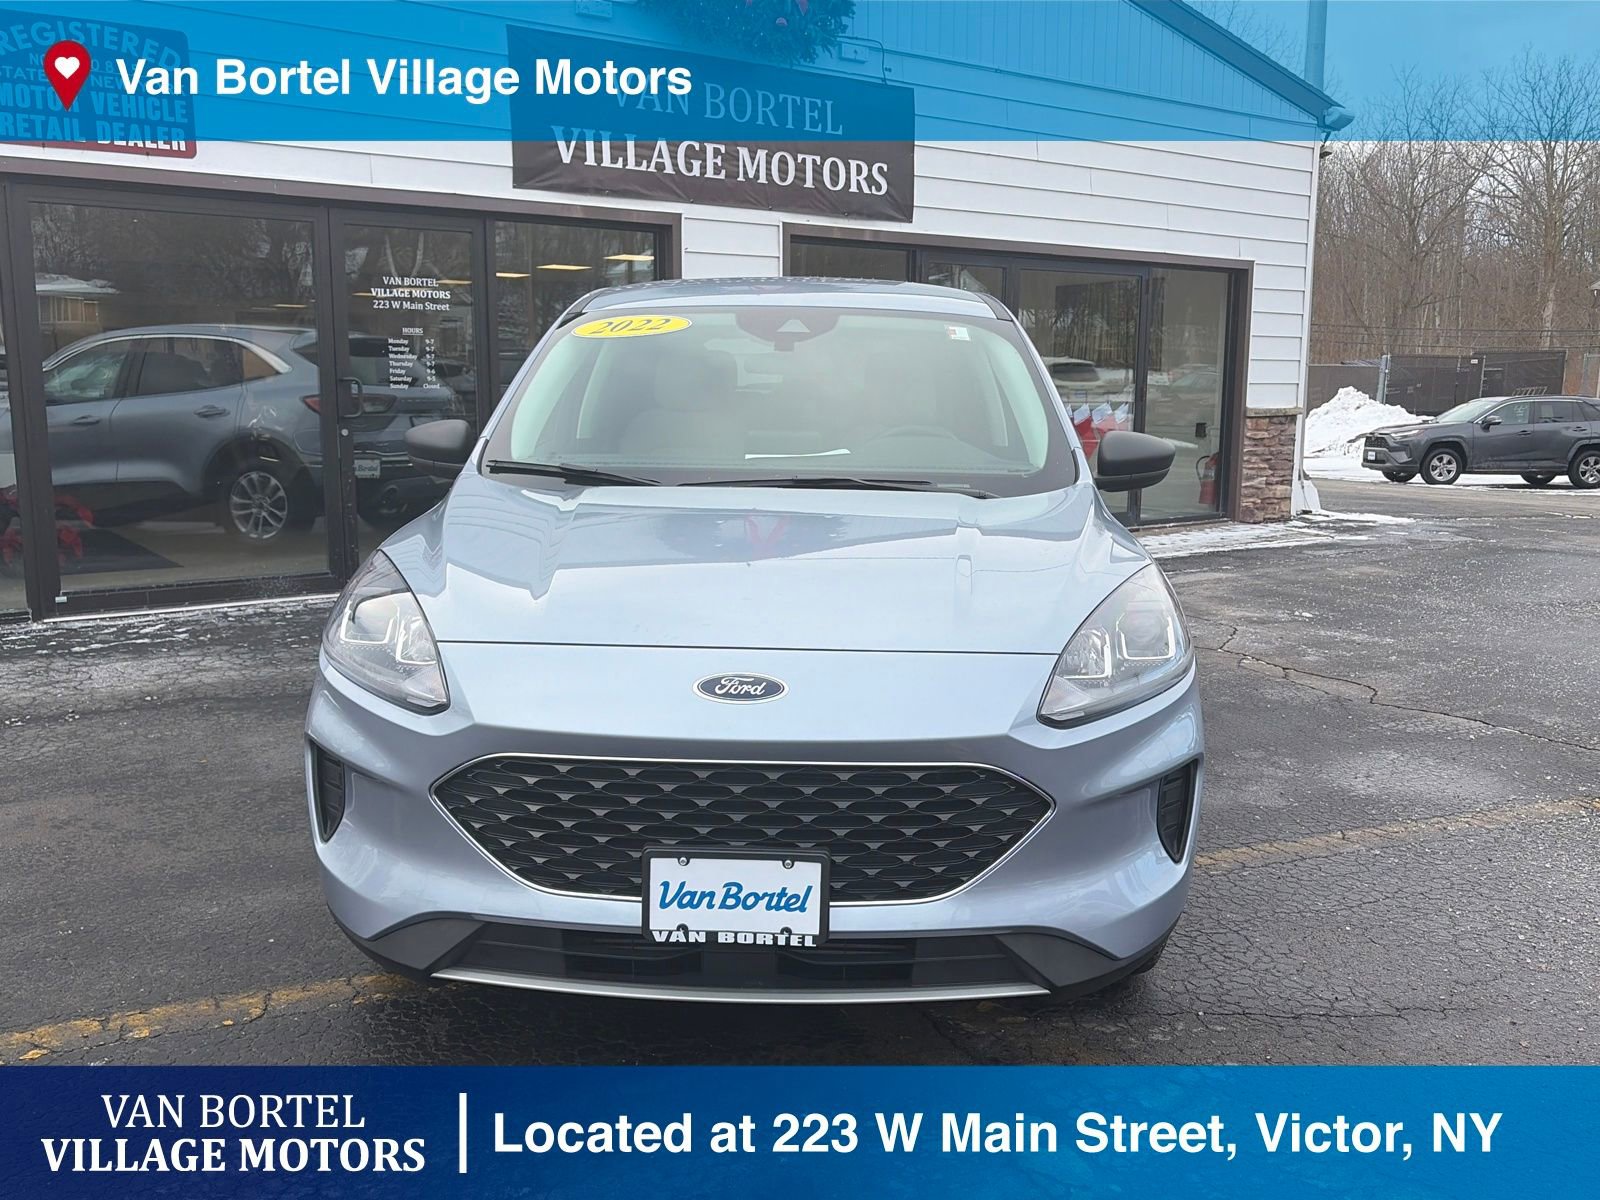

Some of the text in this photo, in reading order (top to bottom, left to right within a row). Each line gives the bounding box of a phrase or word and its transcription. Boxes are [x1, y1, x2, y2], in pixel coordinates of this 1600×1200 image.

[0, 65, 49, 82] TATE
[90, 91, 189, 124] VEHICLE
[703, 81, 844, 136] BORTEL
[0, 111, 87, 143] RETAIL
[96, 120, 187, 152] DEALER
[551, 125, 889, 196] VILLAGE MOTORS
[382, 276, 439, 287] VAN BORTEL
[370, 287, 451, 299] VILLAGE MOTORS
[372, 300, 450, 311] 223 W Main Street
[402, 327, 424, 335] HOURS
[587, 318, 672, 335] 2022
[714, 676, 767, 696] Ford
[659, 880, 813, 912] Van Bortel
[652, 930, 817, 947] VAN BORTEL
